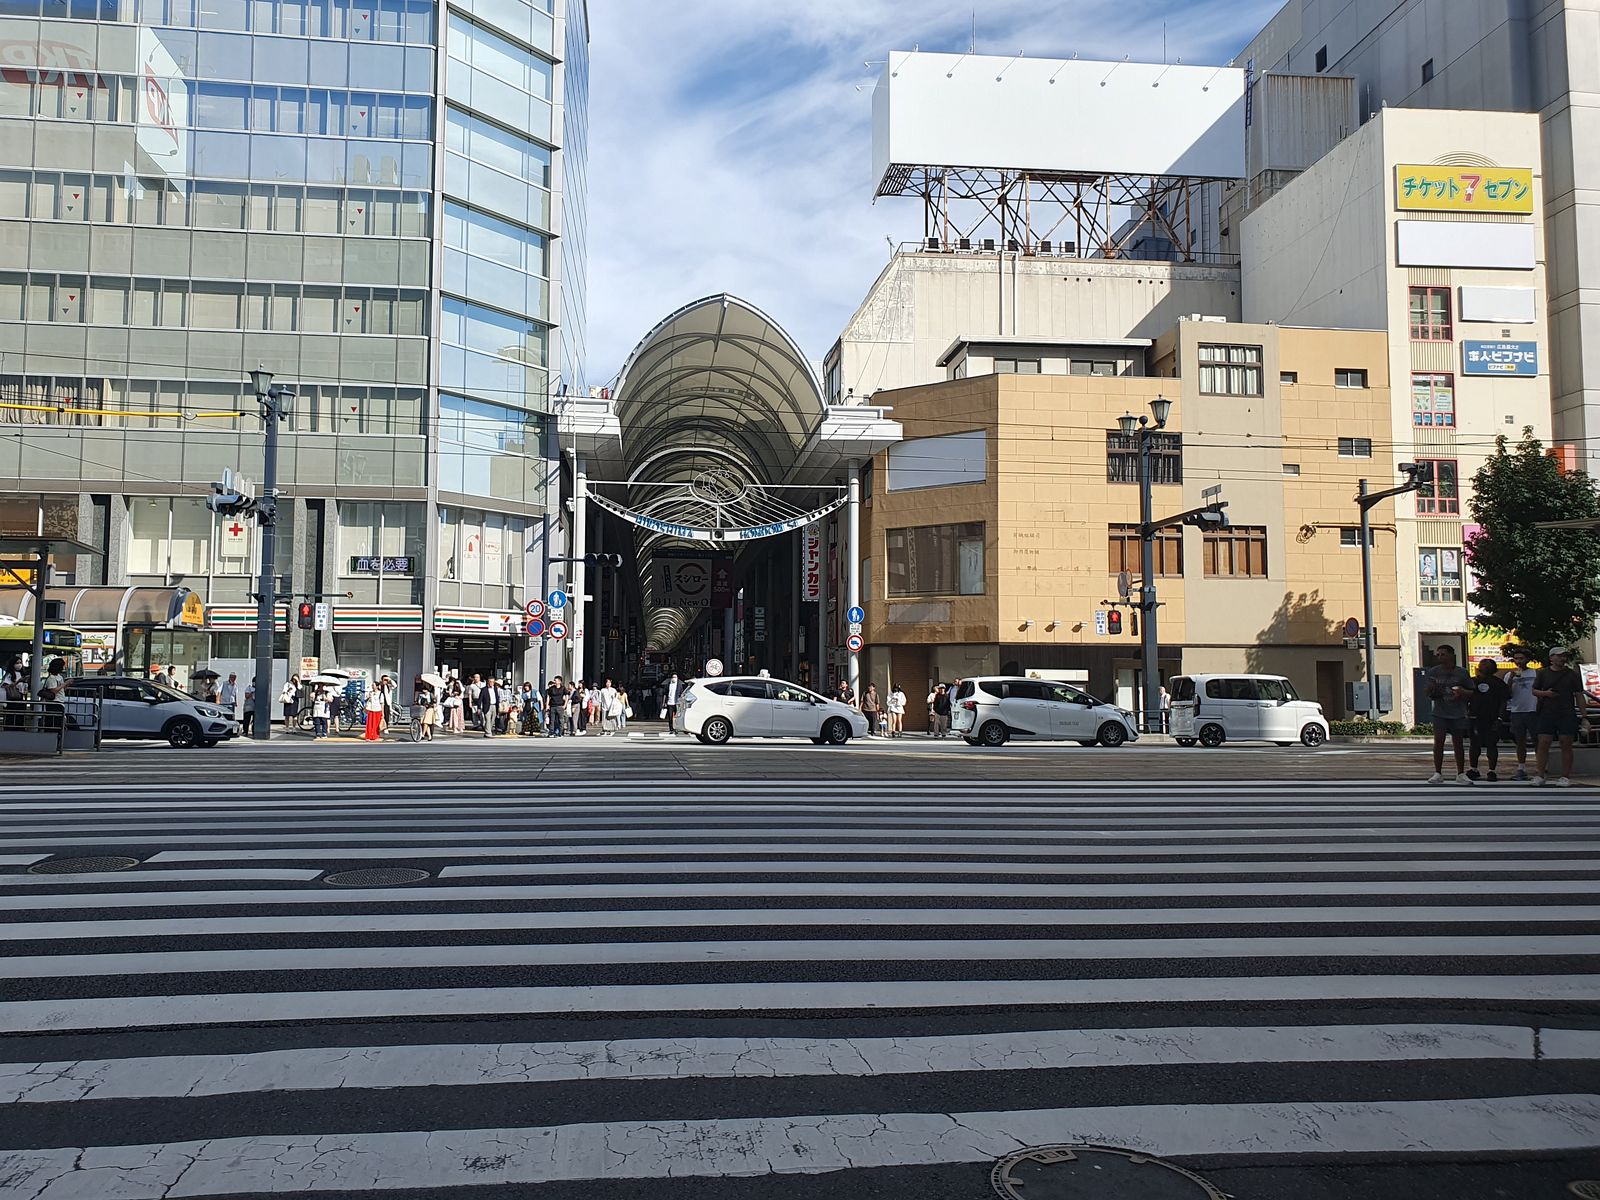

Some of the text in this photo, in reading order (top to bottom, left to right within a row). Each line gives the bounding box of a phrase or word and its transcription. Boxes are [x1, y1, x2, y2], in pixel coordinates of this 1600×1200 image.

[356, 557, 409, 571] 血を必要
[807, 537, 819, 597] ジャンカラ
[673, 575, 709, 584] スシロー
[679, 598, 699, 606] New
[530, 604, 541, 613] 20
